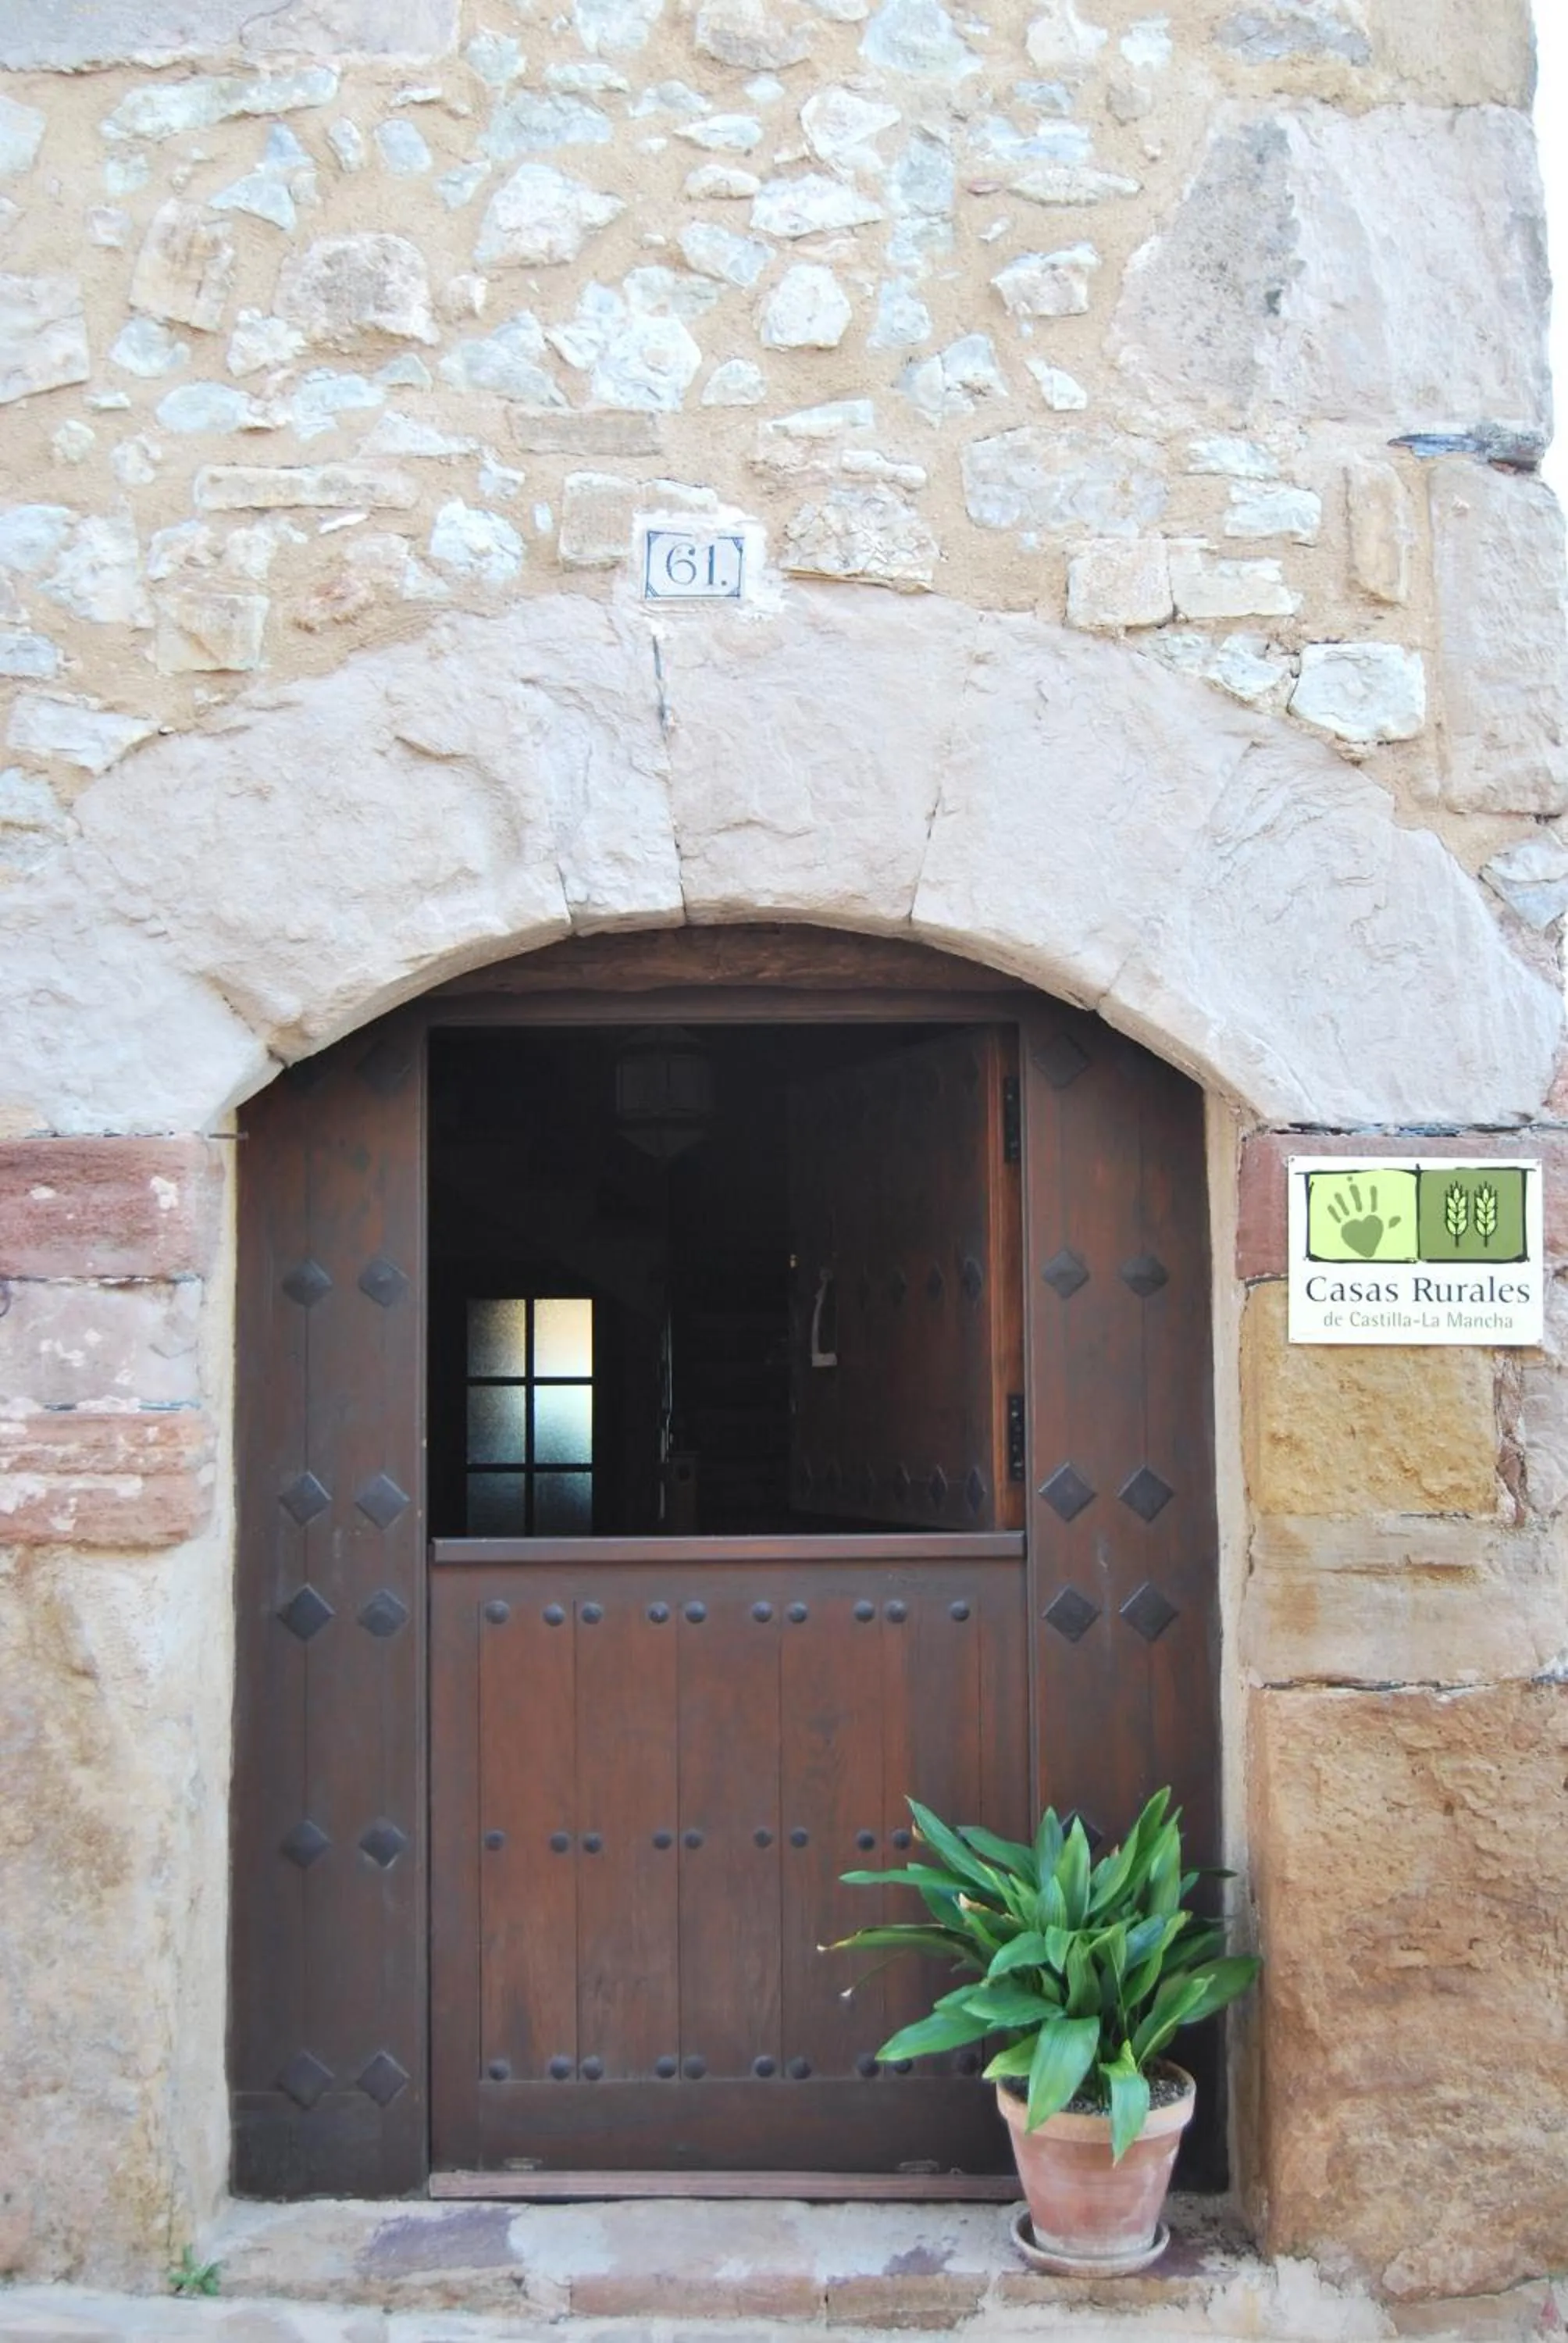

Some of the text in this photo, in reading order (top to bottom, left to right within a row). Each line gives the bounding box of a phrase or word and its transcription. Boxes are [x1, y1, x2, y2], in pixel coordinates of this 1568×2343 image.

[666, 542, 728, 586] 61.
[1305, 1275, 1531, 1303] Casas Rurales
[1324, 1311, 1513, 1329] de Castilla-La Mancha
